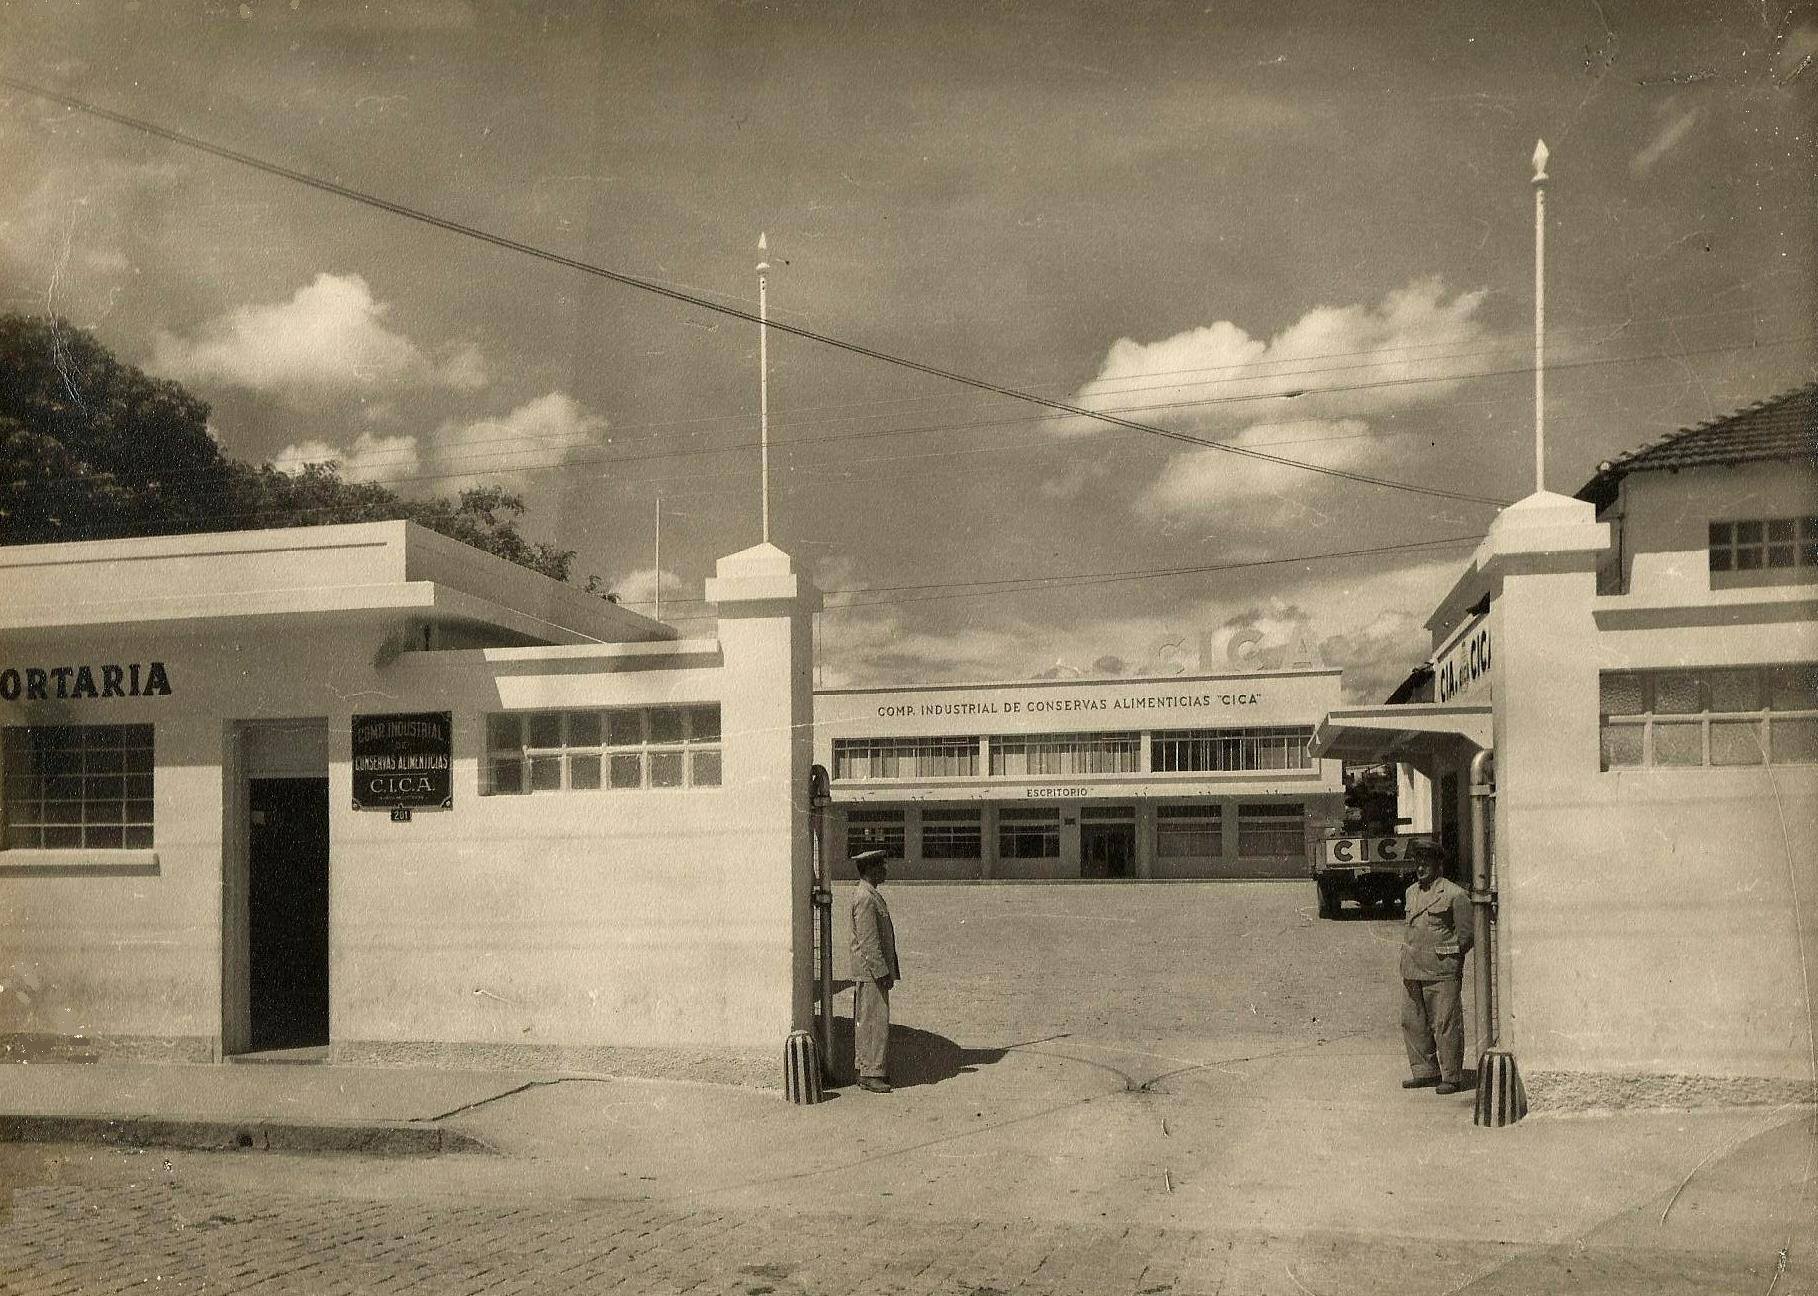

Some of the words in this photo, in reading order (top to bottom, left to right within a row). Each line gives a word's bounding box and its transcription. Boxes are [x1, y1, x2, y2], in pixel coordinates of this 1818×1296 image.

[877, 706, 916, 717] COMP.
[921, 702, 998, 716] INDUSTRIAL
[1004, 702, 1021, 713] DE
[1027, 699, 1107, 712] CONSERVAS
[1113, 695, 1211, 710] ALIMENTICIAS
[1217, 693, 1262, 706] "CICA"
[387, 721, 444, 741] INDUSTRIAL
[355, 755, 396, 771] CONSERVAS
[398, 753, 448, 770] ALIMENTICIAS
[370, 777, 435, 793] C.I.C.A.
[1026, 788, 1088, 798] ESCRITORIO
